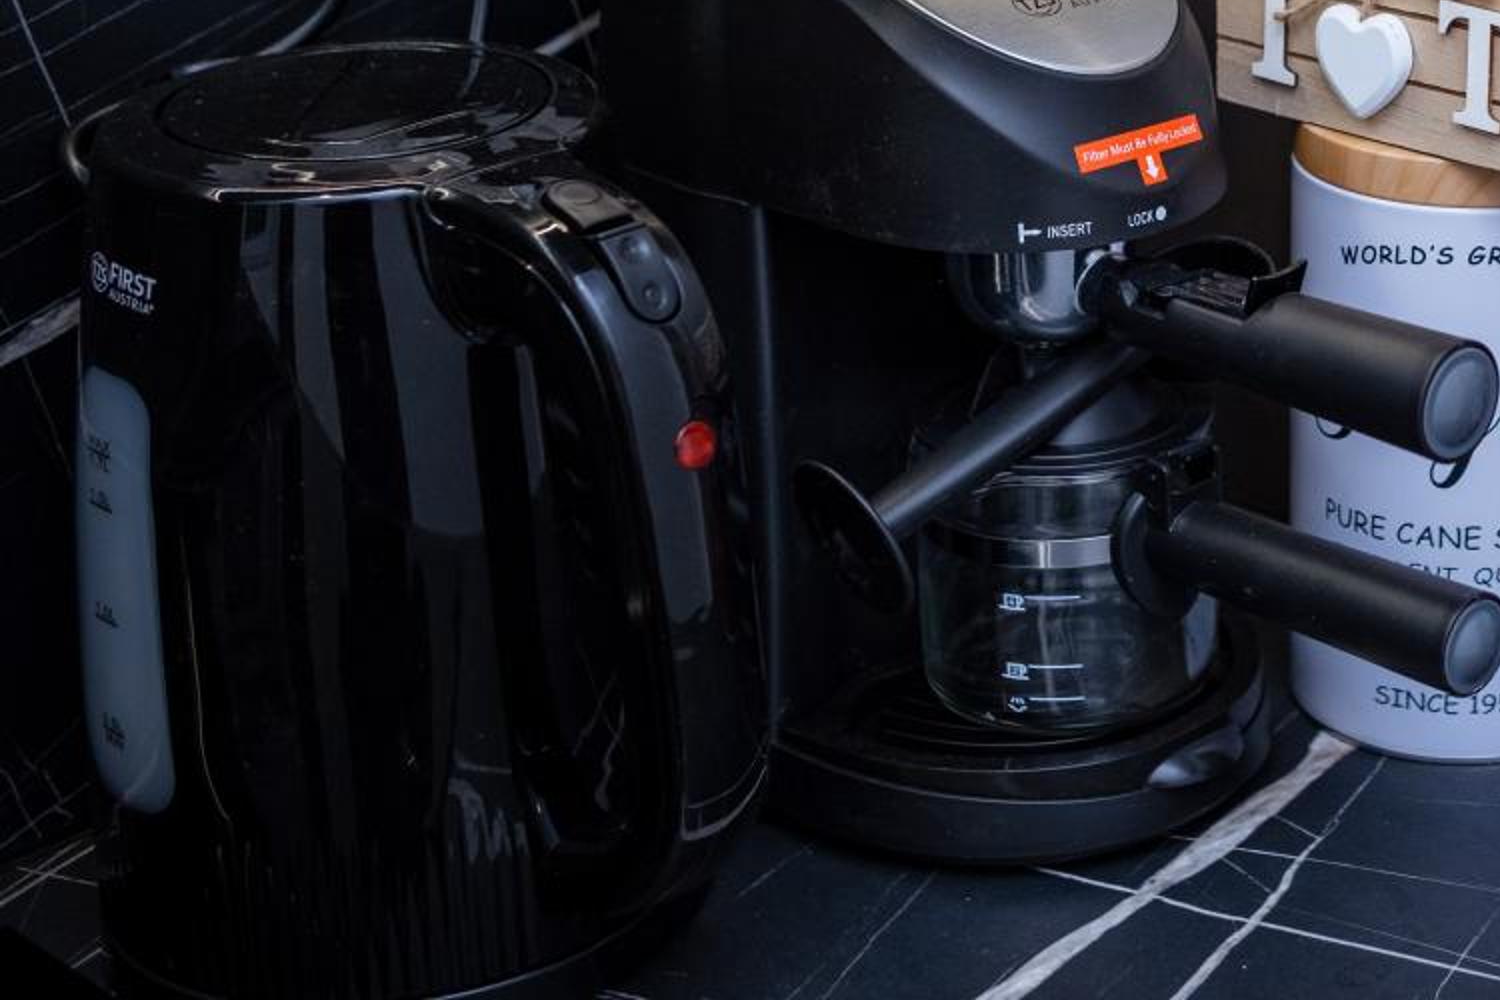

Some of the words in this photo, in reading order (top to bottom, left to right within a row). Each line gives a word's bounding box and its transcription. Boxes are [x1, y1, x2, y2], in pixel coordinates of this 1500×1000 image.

[1083, 149, 1109, 162] Filter
[1110, 143, 1133, 154] Must
[1147, 131, 1169, 147] Fully
[1047, 221, 1093, 239] INSERT
[1128, 211, 1155, 226] LOCK
[1341, 244, 1454, 267] WORLD'S
[109, 261, 157, 300] FIRST
[1325, 497, 1385, 542] PURE
[1397, 522, 1481, 551] CANE
[1375, 686, 1459, 715] SINCE
